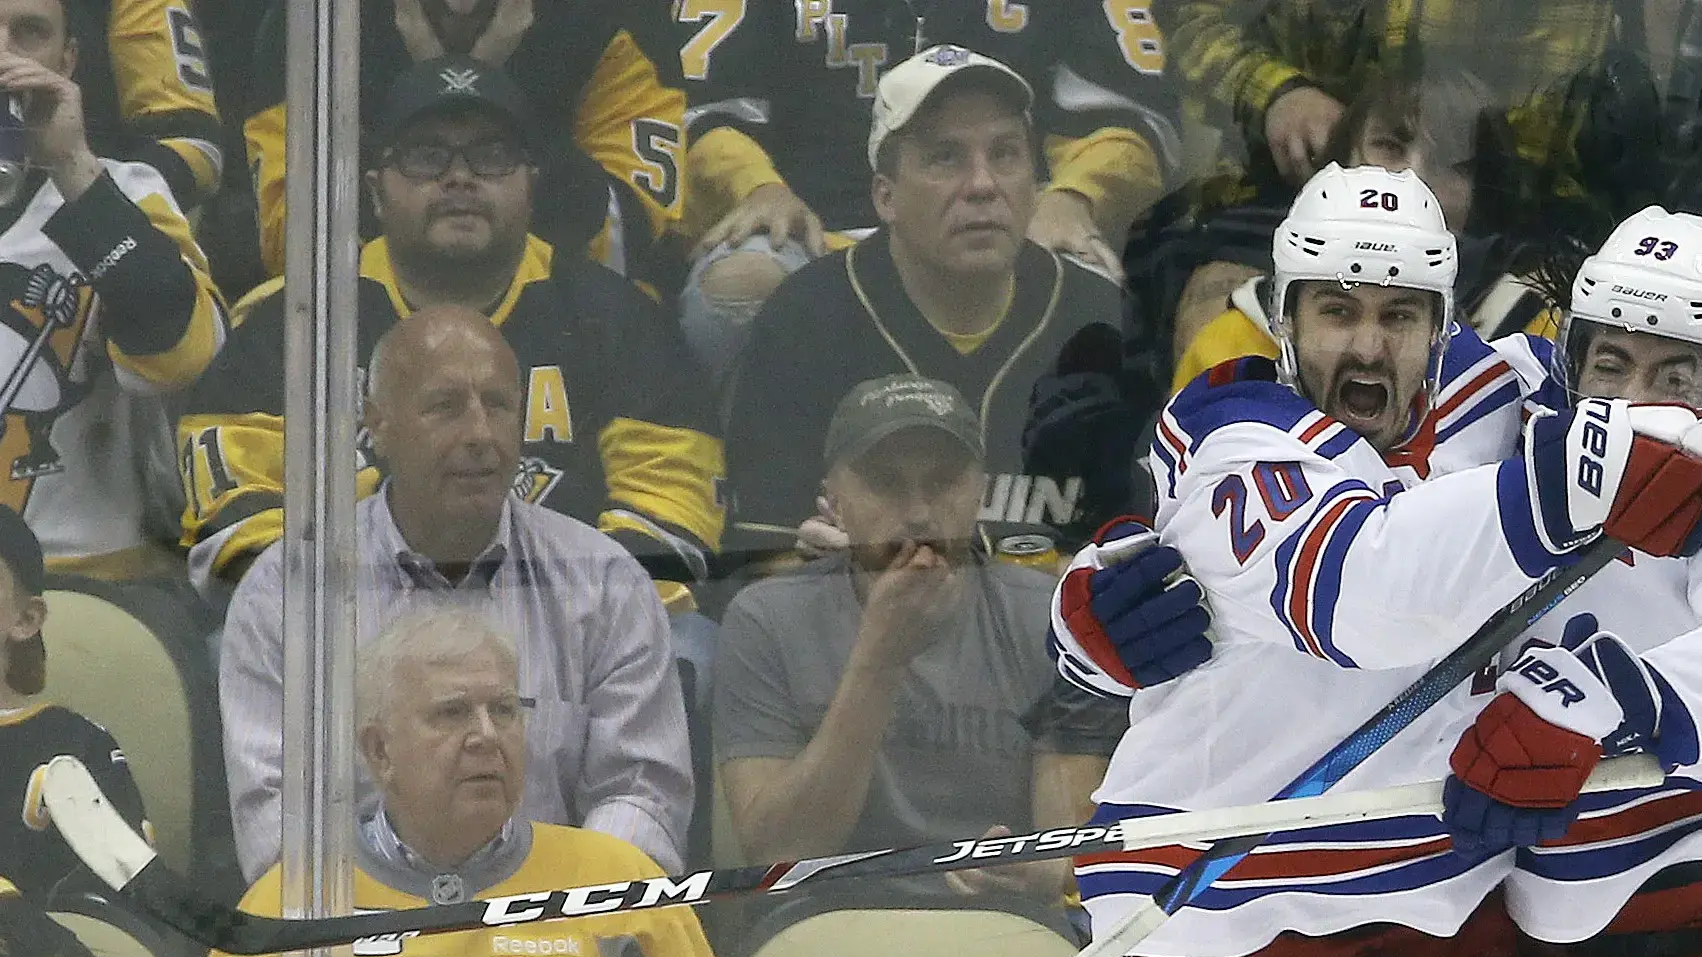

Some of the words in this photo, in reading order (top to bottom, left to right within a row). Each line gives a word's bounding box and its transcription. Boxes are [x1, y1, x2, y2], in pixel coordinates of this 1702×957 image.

[671, 0, 749, 80] 7
[631, 118, 681, 208] 5
[1360, 189, 1399, 212] 20
[1634, 237, 1678, 261] 93
[524, 366, 573, 444] A
[1212, 460, 1314, 567] 20
[482, 871, 714, 926] CCM
[493, 936, 582, 956] Reebok
